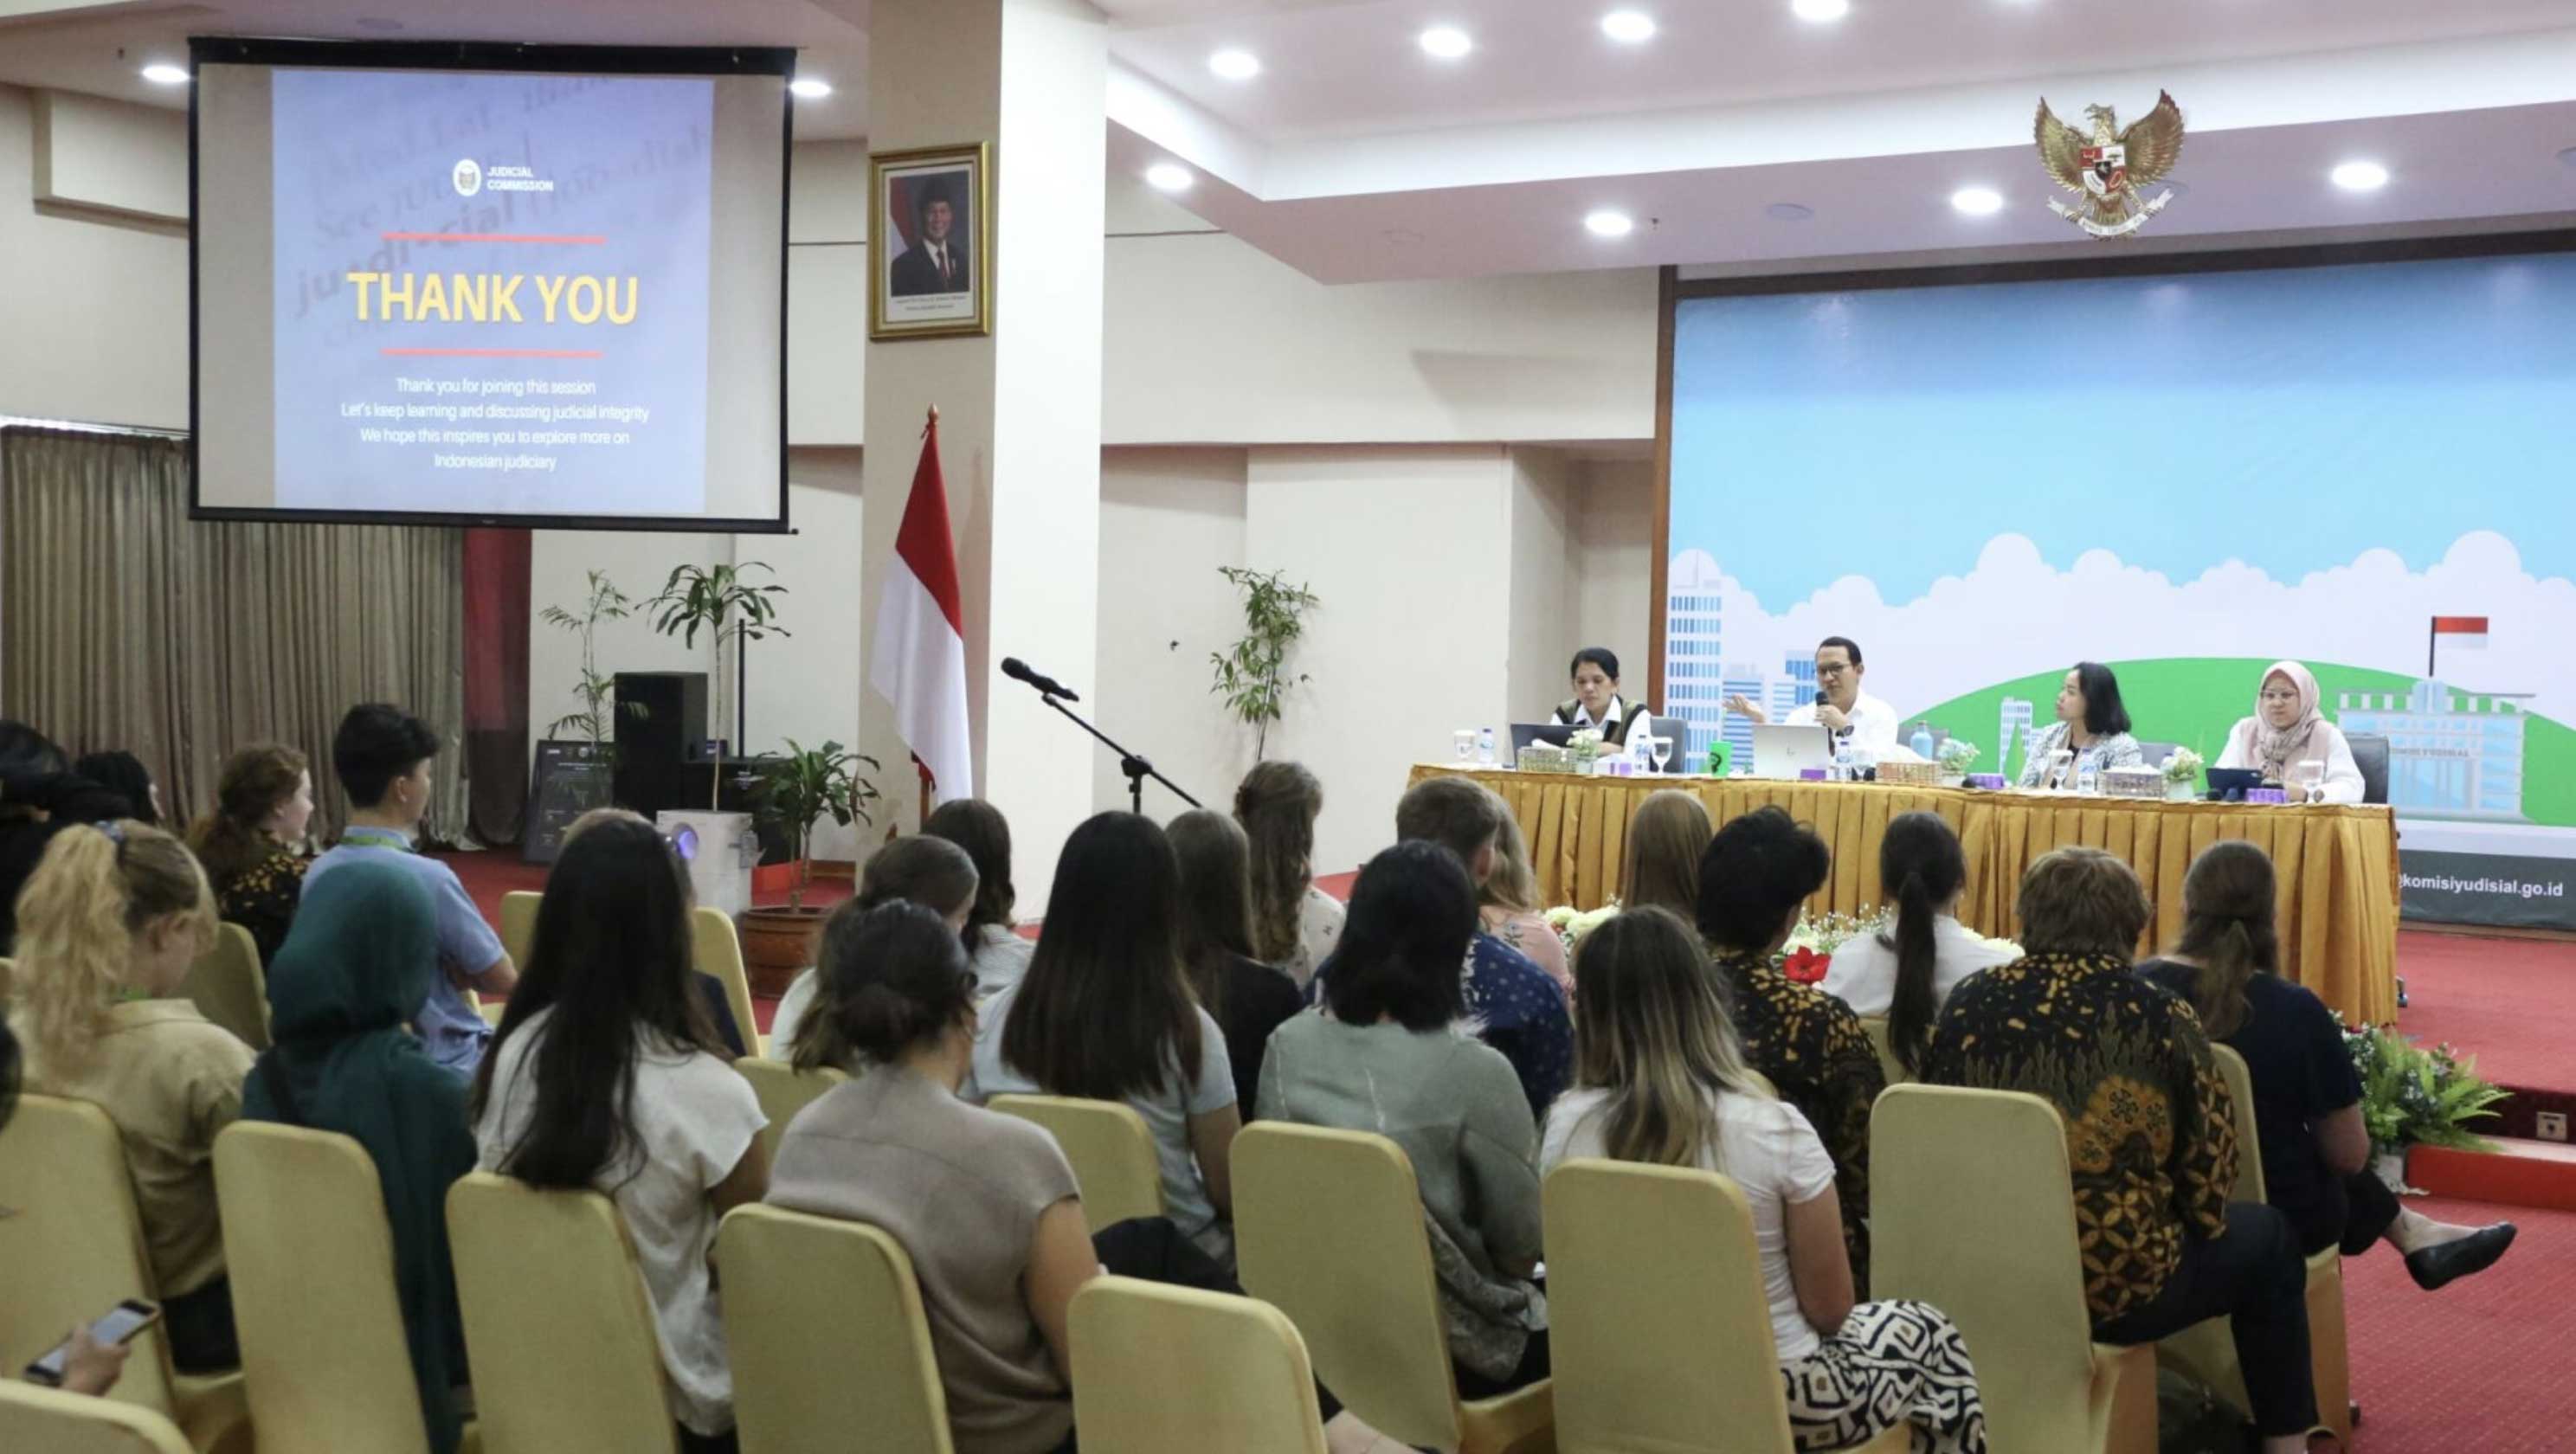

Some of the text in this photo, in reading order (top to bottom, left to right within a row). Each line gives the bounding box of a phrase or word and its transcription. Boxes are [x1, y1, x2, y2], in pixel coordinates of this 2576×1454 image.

[487, 166, 533, 177] JUDICIAL
[487, 180, 554, 191] COMMISSION
[347, 271, 639, 325] THANK YOU
[396, 377, 596, 397] Thank you for joining this session
[374, 402, 404, 420] keep
[407, 403, 457, 421] learning
[460, 404, 483, 418] and
[486, 404, 551, 421] discussing
[551, 405, 596, 422] judicial
[599, 406, 650, 422] integrity
[361, 428, 630, 447] We hope this inspires you to explore more on
[435, 454, 557, 472] Indonesian judiciary
